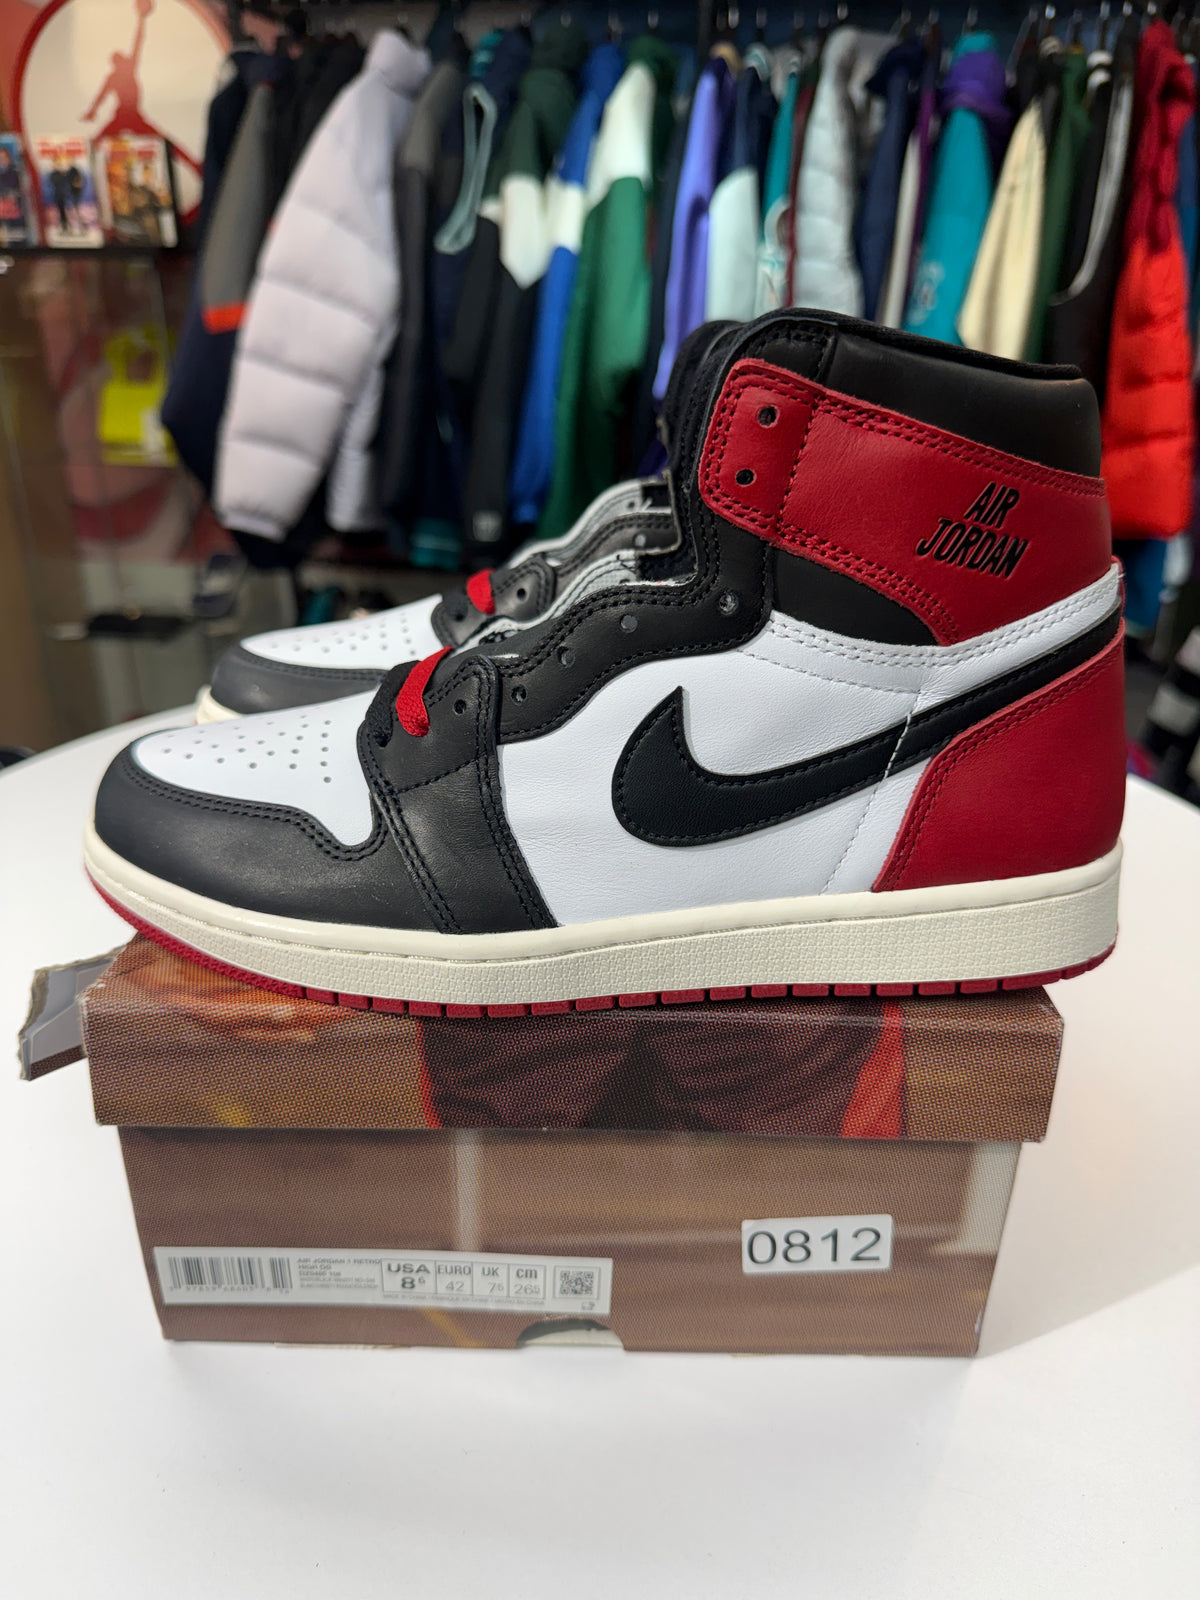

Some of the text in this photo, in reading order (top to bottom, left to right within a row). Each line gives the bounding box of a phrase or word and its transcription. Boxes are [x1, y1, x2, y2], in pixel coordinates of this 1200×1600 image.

[963, 481, 1020, 528] AIR
[915, 517, 1029, 579] JORDAN
[747, 1226, 881, 1264] 0812
[387, 1262, 538, 1279] USA EURO UK cm
[445, 1281, 465, 1292] 42
